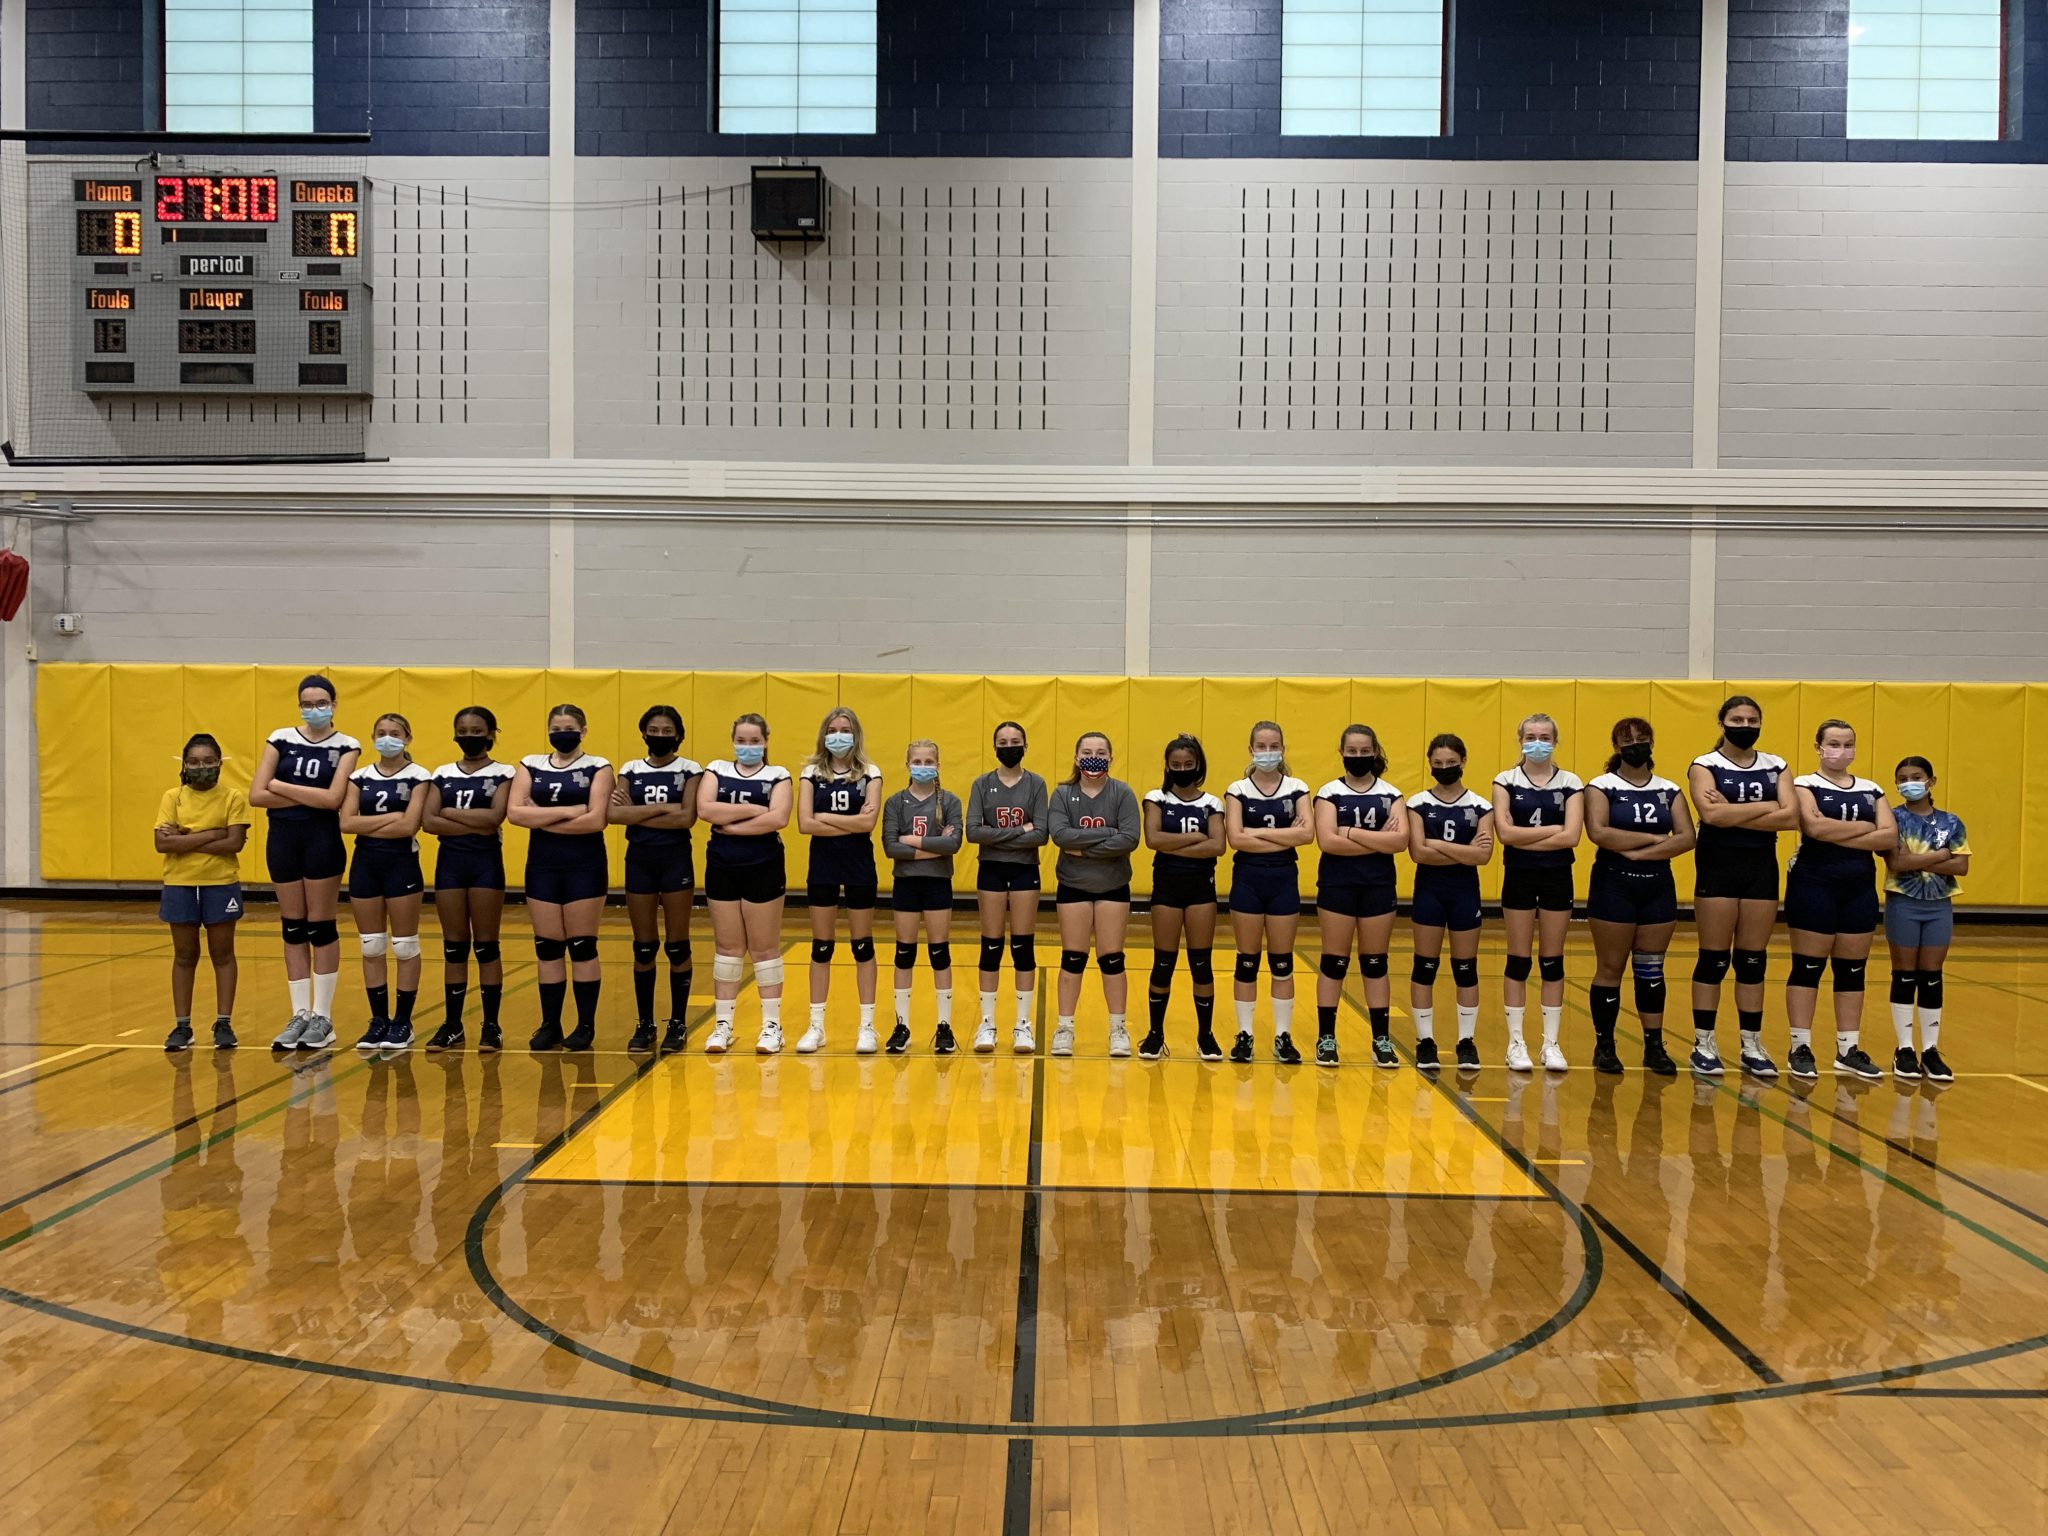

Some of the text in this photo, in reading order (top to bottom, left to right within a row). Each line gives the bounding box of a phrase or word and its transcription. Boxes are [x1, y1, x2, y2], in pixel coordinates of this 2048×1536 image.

[85, 181, 132, 202] Home
[157, 177, 277, 221] 27:00
[295, 182, 353, 203] Guests
[114, 211, 141, 255] 0
[190, 255, 244, 276] period
[91, 290, 130, 309] fouls
[189, 289, 243, 310] player
[304, 291, 343, 310] fouls
[294, 757, 320, 779] 10
[375, 790, 388, 812] 2
[455, 789, 475, 809] 17
[549, 782, 562, 802] 7
[644, 785, 668, 805] 26
[830, 790, 849, 811] 19
[1737, 781, 1763, 802] 13
[996, 807, 1025, 829] 53
[1353, 807, 1376, 829] 14
[1529, 807, 1542, 827] 4
[1633, 802, 1658, 823] 12
[1840, 803, 1858, 822] 11
[912, 815, 928, 837] 5
[1179, 816, 1200, 833] 16
[1443, 819, 1456, 842] 6
